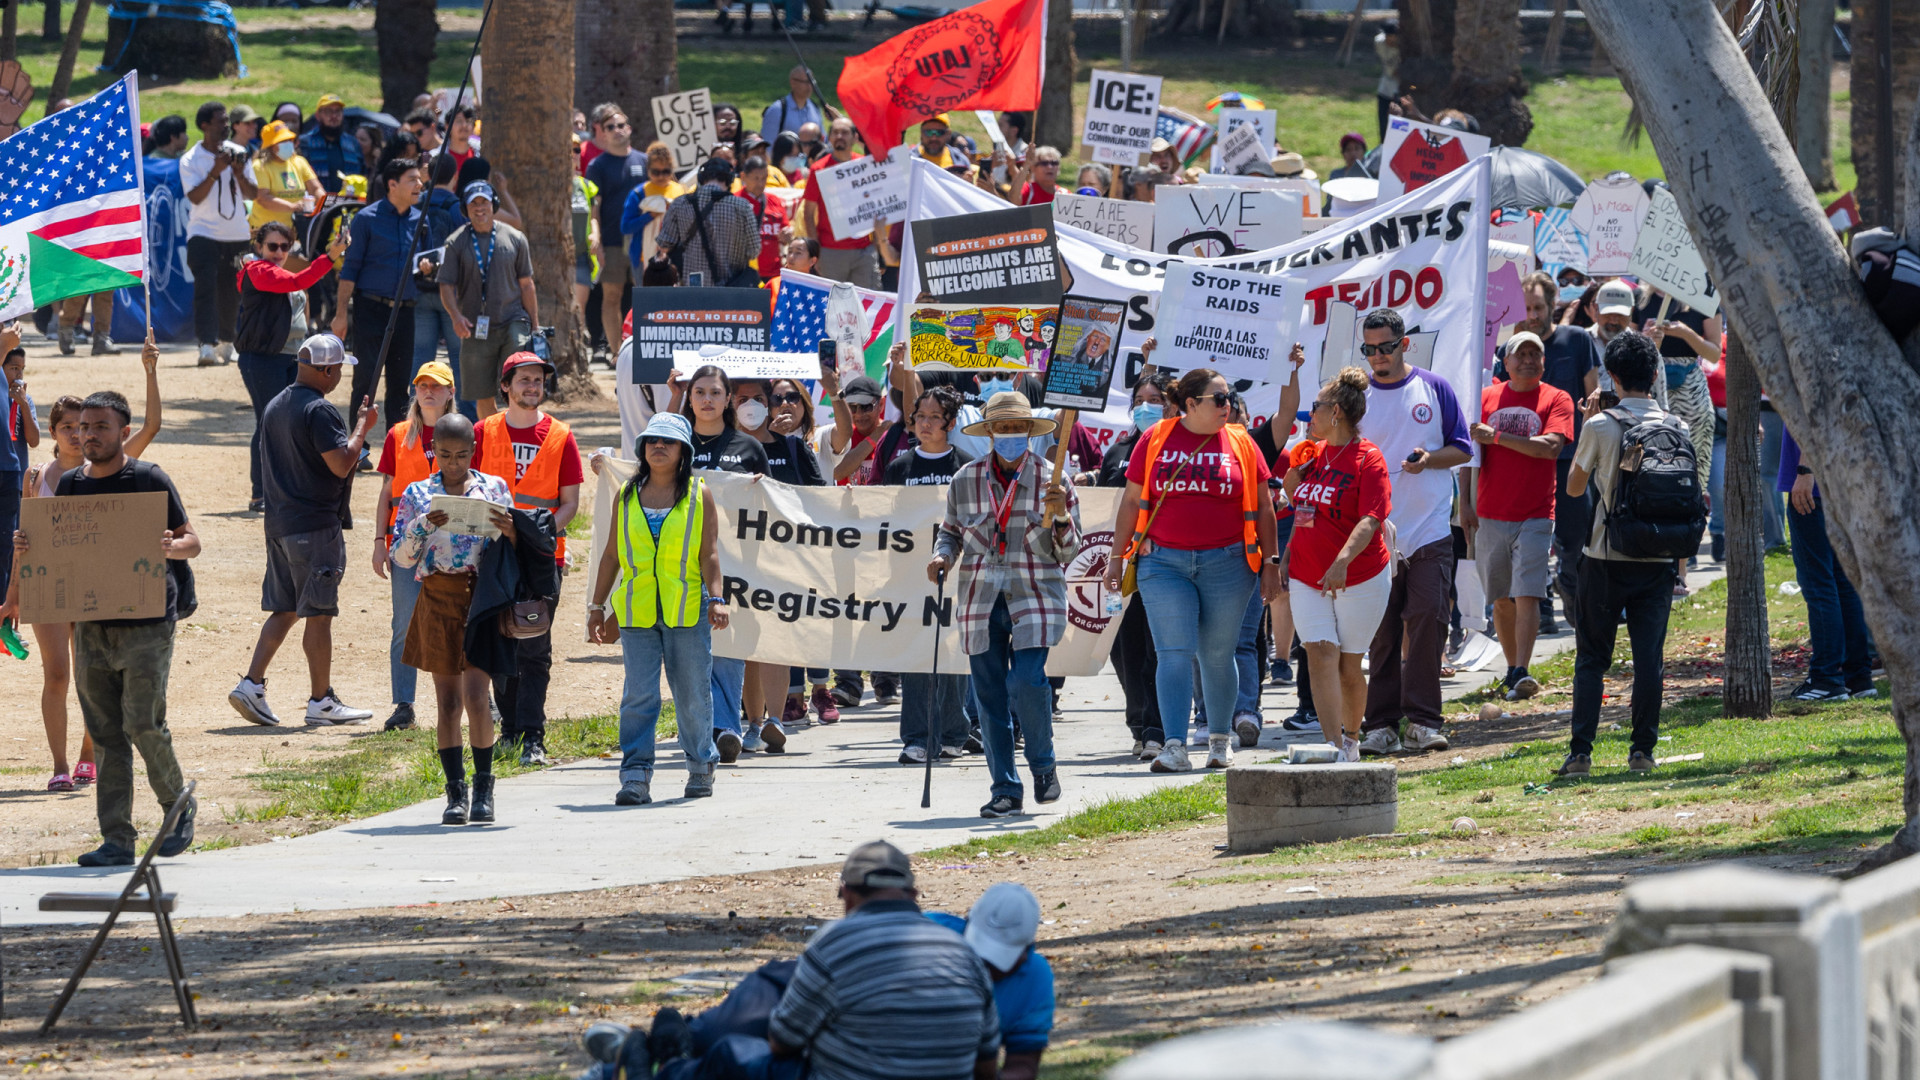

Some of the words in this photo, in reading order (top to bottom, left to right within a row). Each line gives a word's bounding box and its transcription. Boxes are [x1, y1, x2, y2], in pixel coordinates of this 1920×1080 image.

[1094, 78, 1154, 115] ICE:
[658, 93, 705, 118] ICE
[660, 111, 709, 135] OUT
[1089, 121, 1110, 132] OUT
[1112, 125, 1127, 135] OF
[1129, 127, 1151, 138] OUR
[678, 131, 701, 146] OF
[676, 145, 709, 167] LA
[1416, 148, 1444, 160] HECHO
[835, 163, 867, 180] STOP
[1422, 160, 1436, 170] POR
[852, 171, 887, 188] RAIDS
[1056, 197, 1087, 219] WE
[1096, 201, 1127, 222] ARE
[1190, 192, 1262, 227] WE
[931, 245, 947, 254] NO
[989, 238, 1005, 247] NO
[1009, 233, 1042, 243] FEAR:
[1657, 239, 1681, 258] LOS
[925, 250, 1021, 278] IMMIGRANTS
[1024, 246, 1053, 264] ARE
[927, 270, 1006, 296] WELCOME
[1010, 263, 1056, 285] HERE!
[1634, 247, 1701, 296] ANGELES
[1192, 271, 1241, 291] STOP
[1246, 281, 1282, 297] THE
[1305, 266, 1443, 326] TEJIDO
[1206, 296, 1260, 314] RAIDS
[648, 312, 664, 320] NO
[725, 314, 757, 322] FEAR:
[640, 326, 733, 342] IMMIGRANTS
[737, 328, 765, 343] ARE
[1192, 325, 1222, 339] ¡ALTO
[1225, 330, 1232, 341] A
[1236, 331, 1257, 344] LAS
[911, 342, 930, 354] FAST
[933, 341, 959, 352] FOOD
[1174, 336, 1269, 360] DEPORTACIONES!
[960, 352, 1000, 368] UNION
[1499, 421, 1529, 430] WORKER
[1500, 413, 1532, 422] GARMENT
[1162, 450, 1231, 466] UNITE
[1156, 480, 1209, 492] LOCAL
[1220, 483, 1233, 495] 11
[46, 500, 125, 514] IMMIGRANTS
[1329, 508, 1342, 520] 11
[52, 512, 94, 526] MAKE
[54, 522, 99, 535] AMERICA
[736, 508, 862, 549] Home
[878, 522, 915, 553] is
[52, 532, 103, 548] GREAT
[723, 575, 907, 632] Registry
